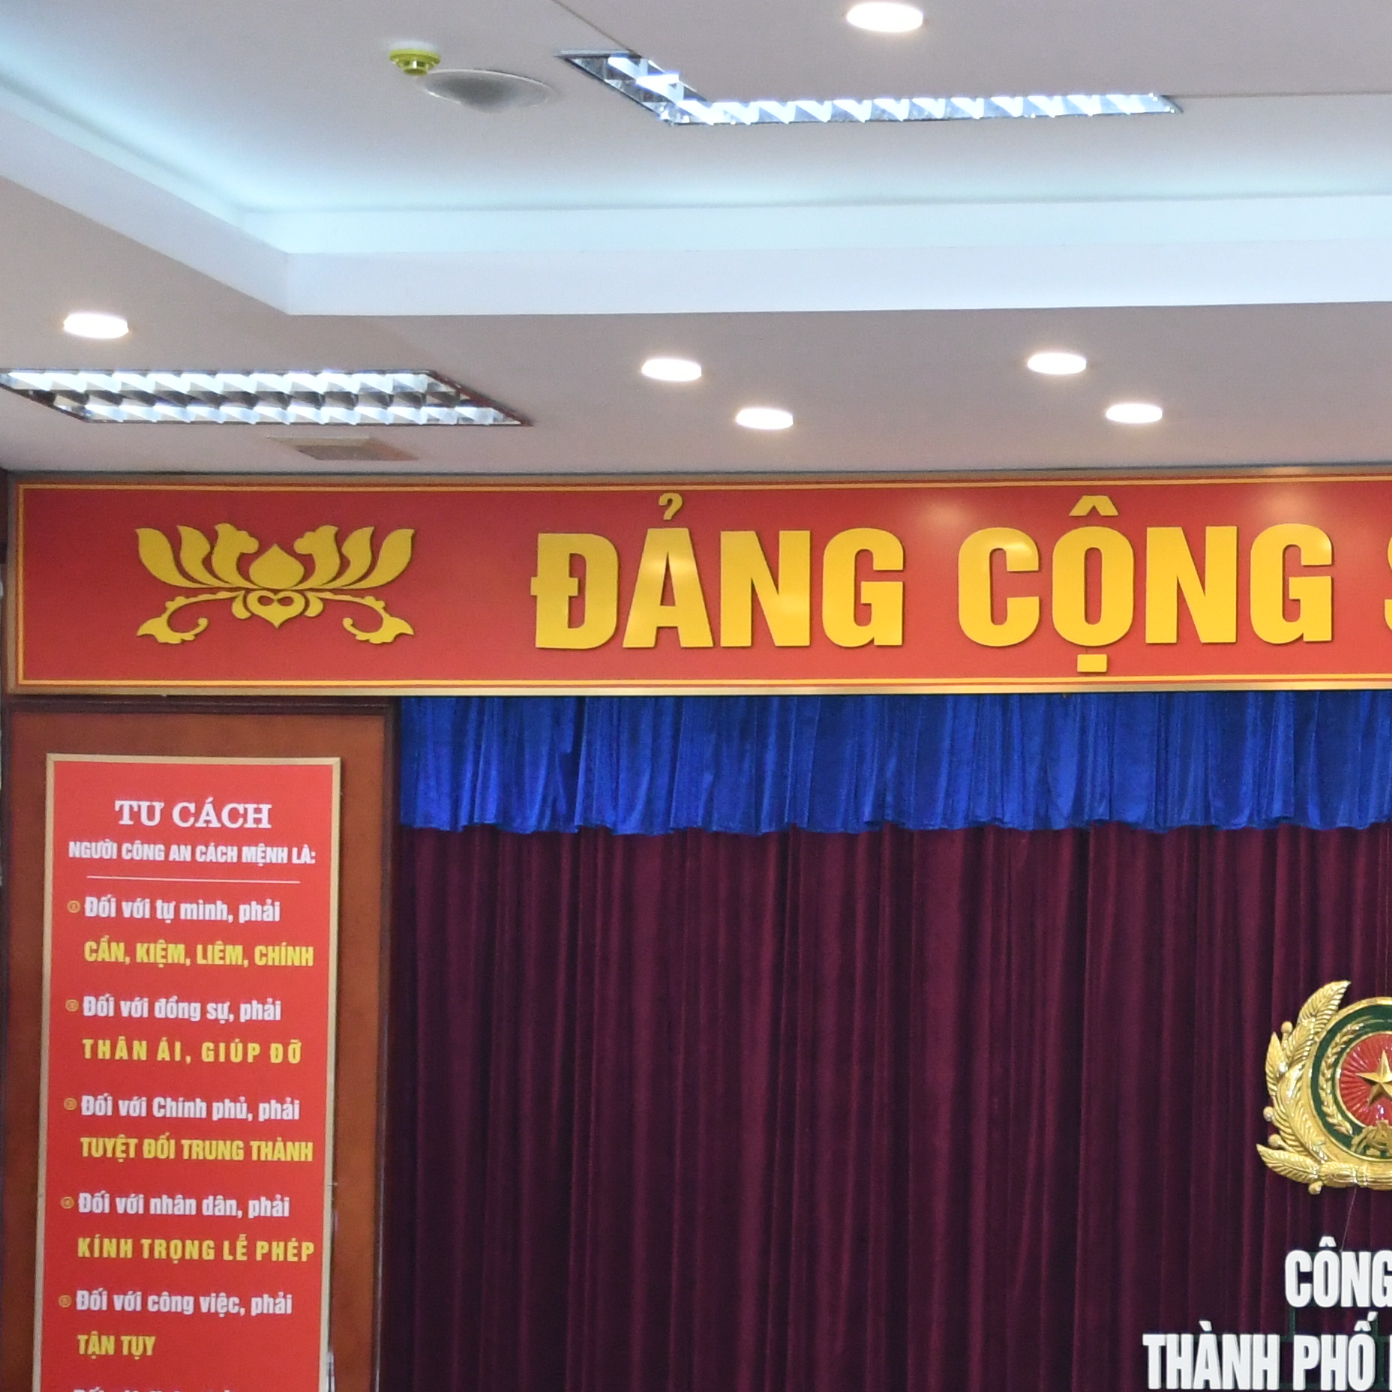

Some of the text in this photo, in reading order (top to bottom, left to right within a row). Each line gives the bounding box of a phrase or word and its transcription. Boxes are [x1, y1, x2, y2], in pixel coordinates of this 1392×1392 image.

[531, 494, 903, 649] ĐẢNG
[958, 496, 1331, 672] CỘNG
[115, 797, 272, 828] TƯ CÁCH
[69, 839, 315, 866] NGƯỜI CÔNG AN CÁCH MỆNH LÀ:
[85, 895, 116, 917] Đối
[122, 898, 150, 918] với
[156, 900, 175, 923] tự
[239, 899, 280, 923] phải
[85, 936, 313, 967] CẦN, KIỆM, LIÊM, CHÍNH
[83, 994, 281, 1023] Đối với đồng sự, phải
[83, 1036, 301, 1063] THÂN ÁI, GIÚP ĐỠ
[81, 1093, 299, 1121] Đối với Chính phủ, phải
[80, 1133, 313, 1162] TUYỆT ĐỐI TRUNG THÀNH
[78, 1191, 289, 1218] Đối với nhân dân, phải
[78, 1234, 314, 1263] KÍNH TRỌNG LỄ PHÉP
[76, 1288, 292, 1317] Đối với công việc, phải
[78, 1331, 155, 1360] TẬN TỤY
[1143, 1321, 1280, 1390] THÀNH
[1293, 1312, 1377, 1391] PHỐ
